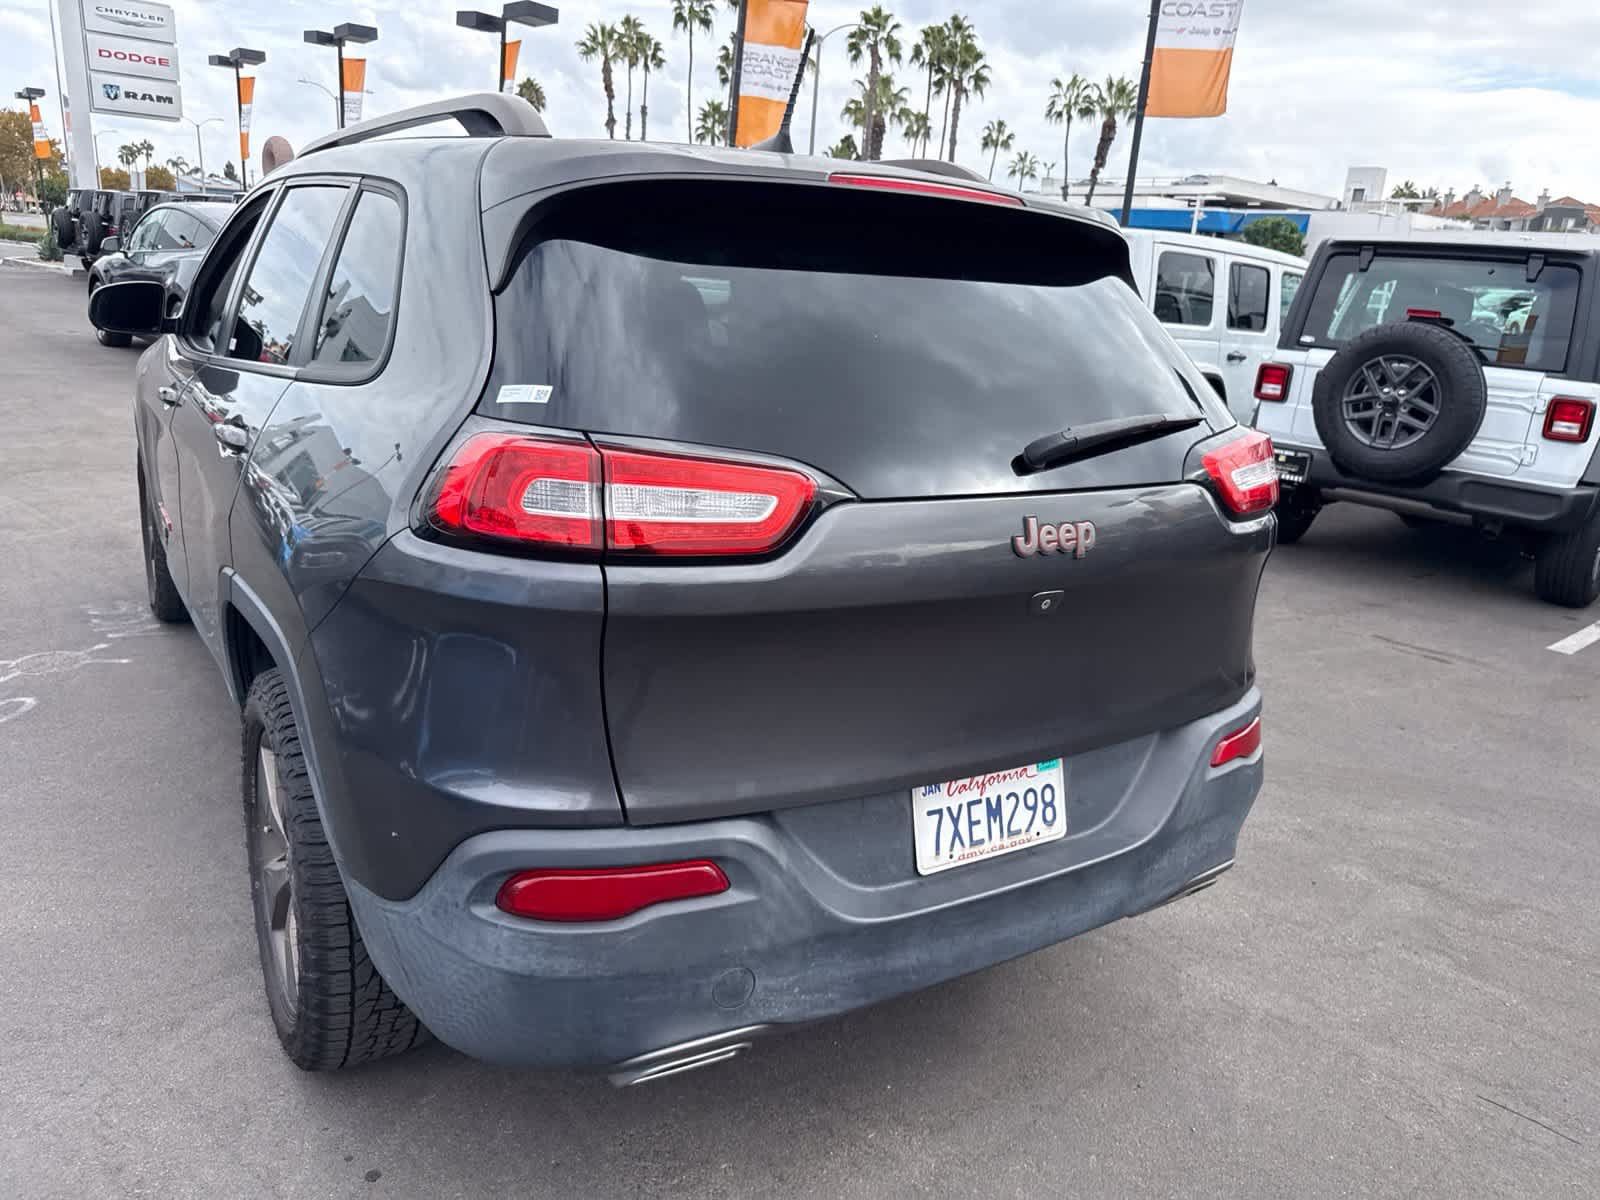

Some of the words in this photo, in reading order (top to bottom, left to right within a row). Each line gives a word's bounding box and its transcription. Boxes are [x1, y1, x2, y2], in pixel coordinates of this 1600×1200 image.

[95, 6, 164, 22] CHRYSLER
[1161, 2, 1238, 17] COAST
[98, 49, 170, 67] DODGE
[743, 64, 793, 80] COAST
[124, 91, 174, 104] RAM
[1011, 515, 1096, 559] Jeep
[946, 767, 1037, 797] California
[922, 784, 942, 797] JAN
[926, 784, 1057, 856] 7XEM298
